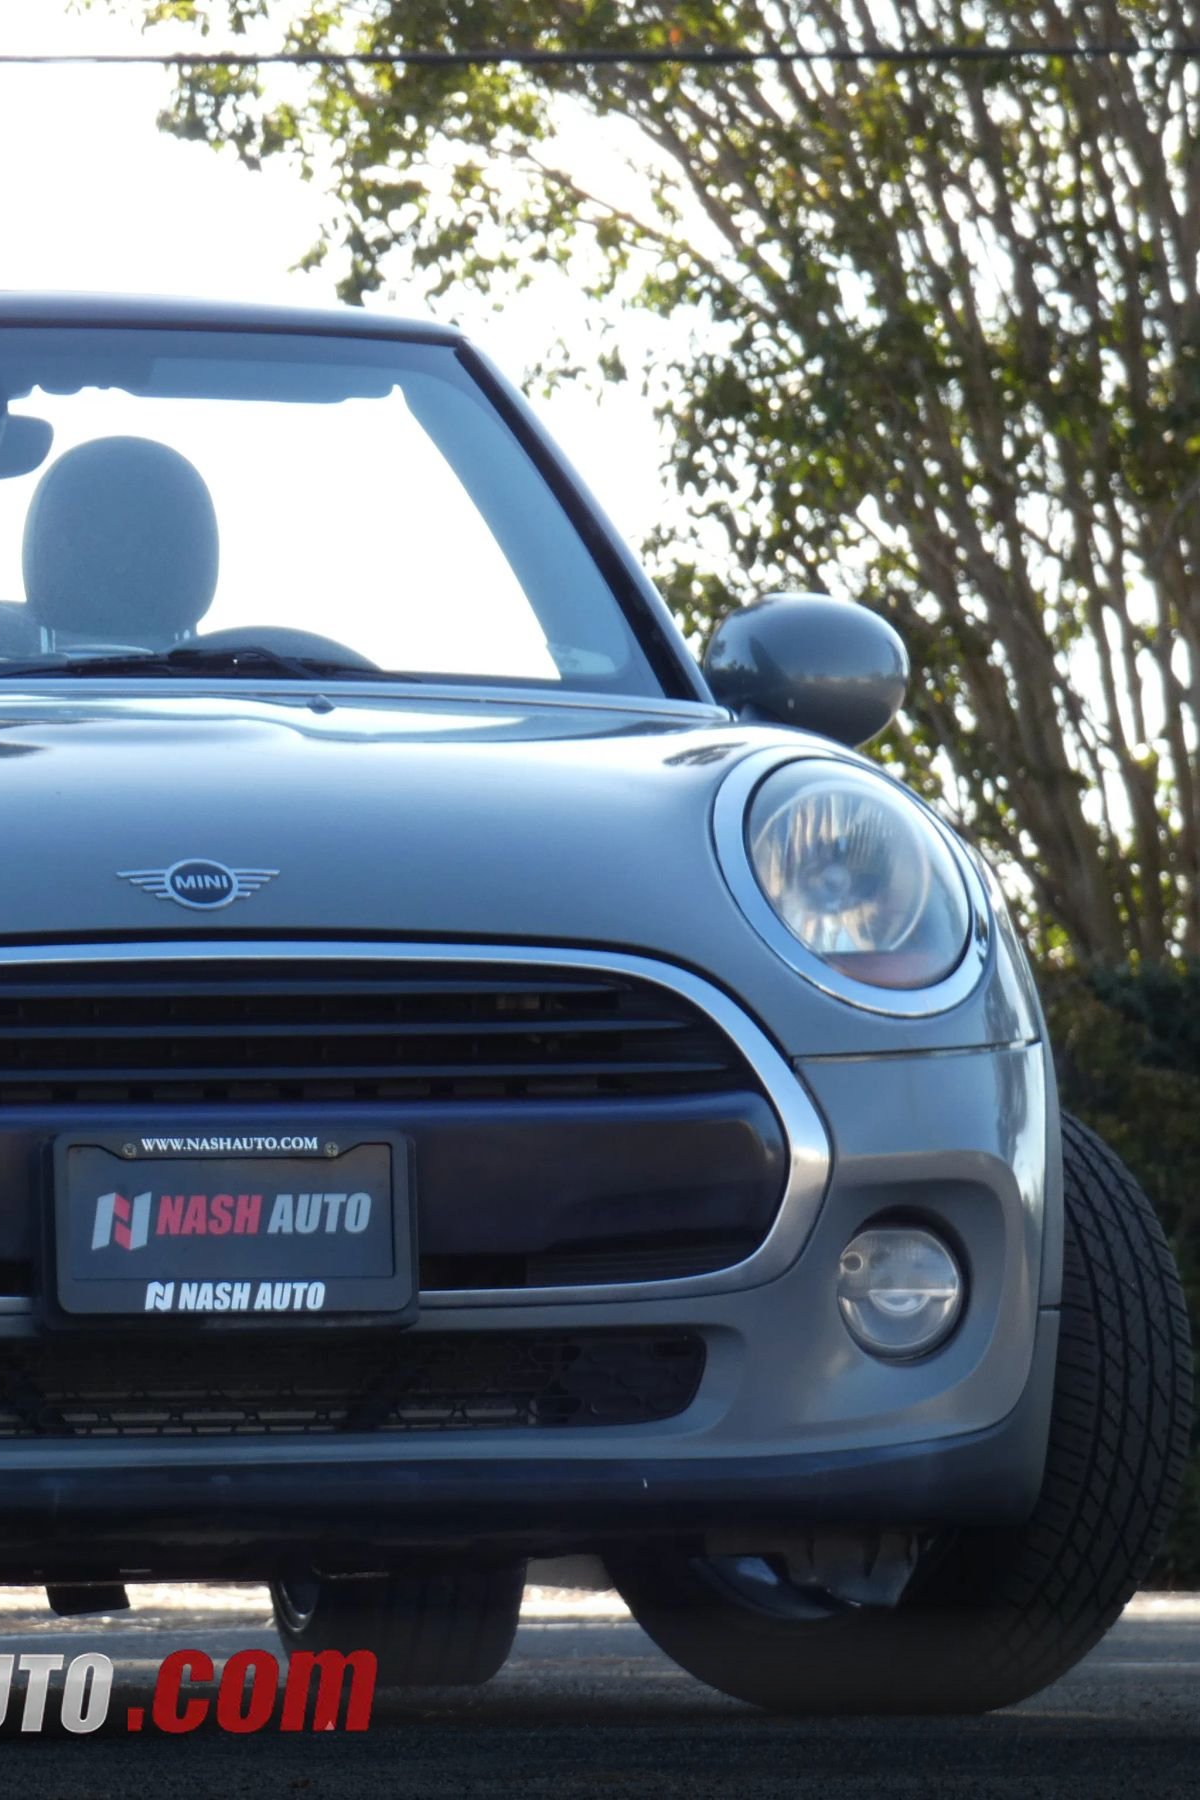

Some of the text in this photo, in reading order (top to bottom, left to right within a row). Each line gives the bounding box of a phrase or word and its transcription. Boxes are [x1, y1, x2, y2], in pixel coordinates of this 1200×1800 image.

[174, 874, 229, 889] MINI
[141, 1137, 319, 1152] WWW.NASHAUTO.COM
[156, 1194, 264, 1236] NASH
[267, 1192, 372, 1235] AUTO
[178, 1282, 251, 1311] NASH
[254, 1281, 326, 1311] AUTO
